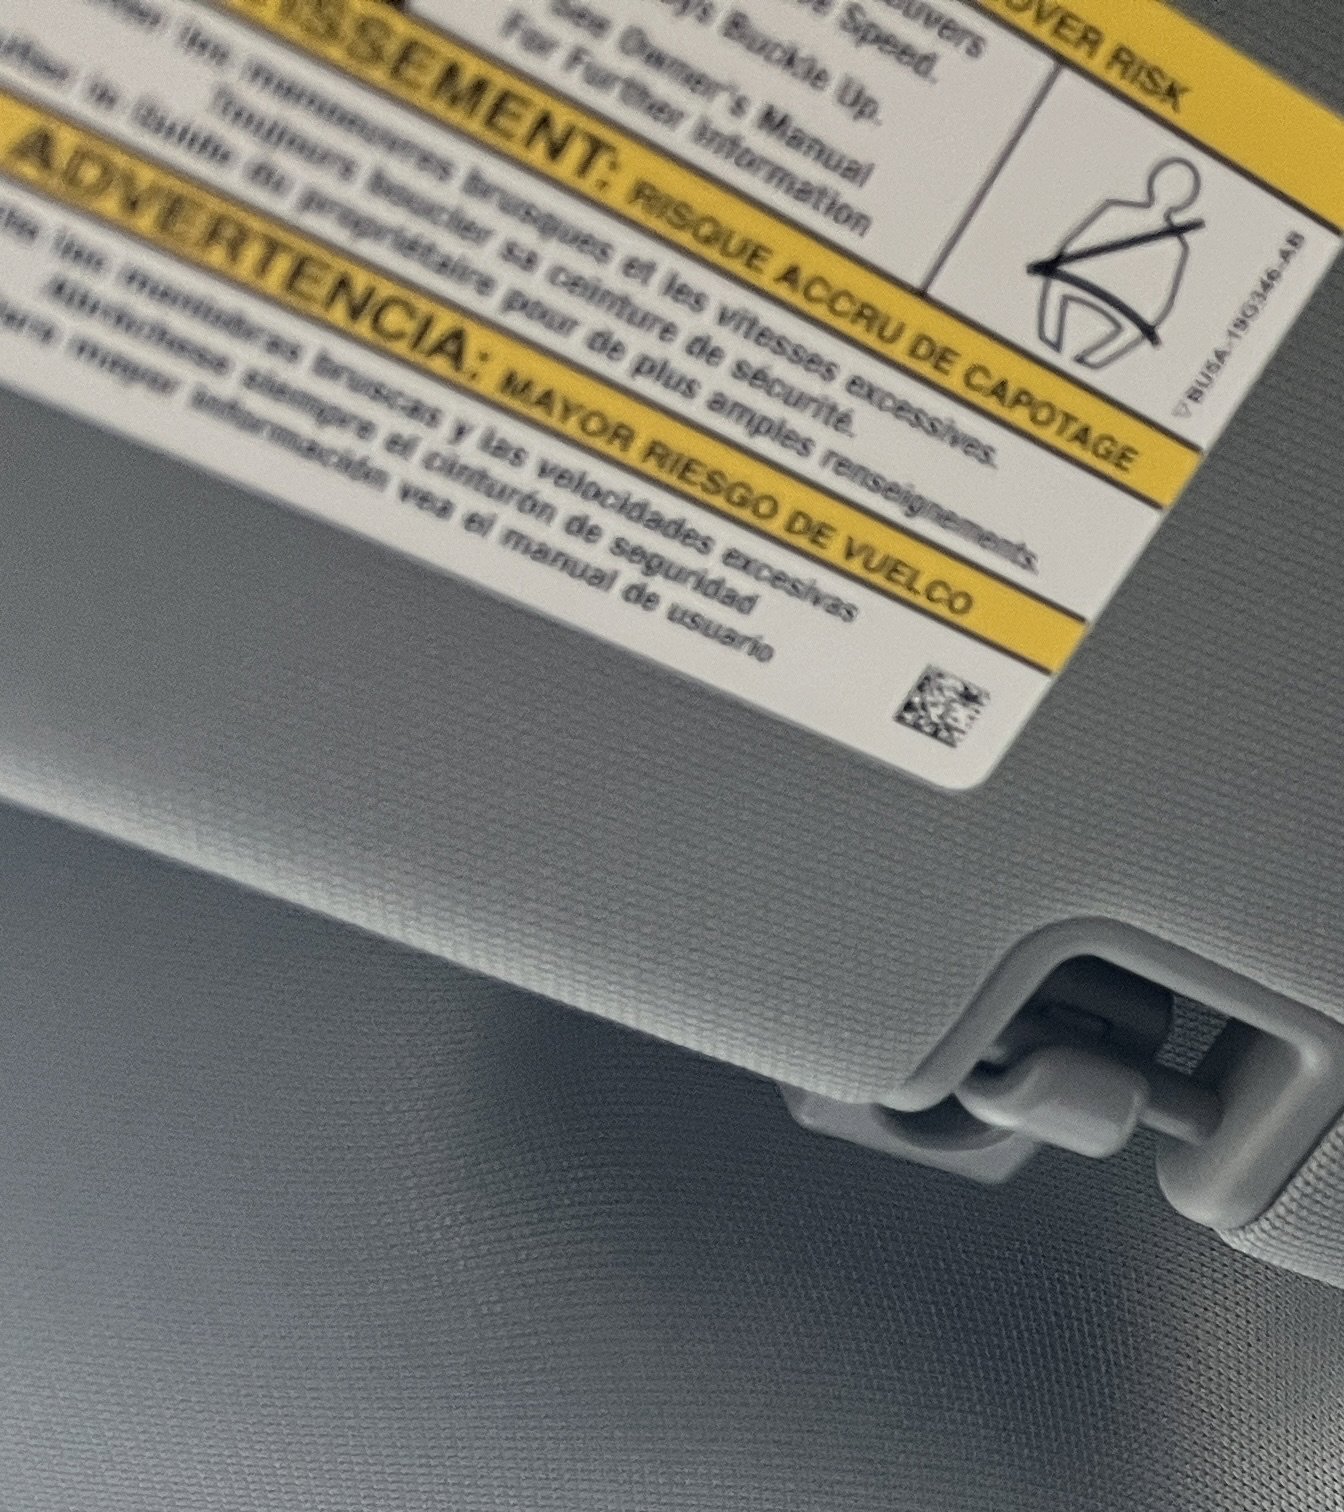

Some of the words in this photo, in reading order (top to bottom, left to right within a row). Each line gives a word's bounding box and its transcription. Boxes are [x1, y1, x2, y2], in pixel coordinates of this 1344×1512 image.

[720, 8, 831, 92] Buckle
[833, 75, 882, 127] Up.
[837, 0, 940, 85] Speed.
[1104, 42, 1191, 114] RISK
[689, 114, 874, 239] Information
[755, 102, 876, 189] Manual
[4, 124, 491, 383] ADVERTENCIA:
[497, 367, 637, 454] MAYOR
[639, 437, 780, 522] RIESGO
[782, 508, 838, 551] DE
[842, 534, 975, 618] VUELCO
[459, 164, 616, 267] brusques
[659, 270, 710, 315] les
[715, 302, 842, 385] vitesses
[843, 373, 998, 471] excessives.
[497, 286, 582, 339] pour
[584, 328, 627, 363] de
[628, 352, 703, 401] plus
[704, 389, 817, 460] amples
[544, 263, 680, 345] ceinture
[683, 333, 727, 368] de
[729, 357, 856, 440] sécurité.
[626, 177, 775, 276] RISQUE
[771, 262, 907, 346] ACCRU
[906, 332, 962, 378] DE
[961, 362, 1140, 474] CAPOTAGE
[398, 481, 455, 521] vea
[461, 510, 498, 539] el
[498, 527, 620, 594] manual
[620, 581, 662, 613] de
[665, 601, 776, 665] usuario
[476, 425, 531, 470] las
[535, 457, 717, 557] velocidades
[720, 546, 860, 625] excesivas
[561, 513, 604, 546] de
[607, 535, 761, 617] seguridad
